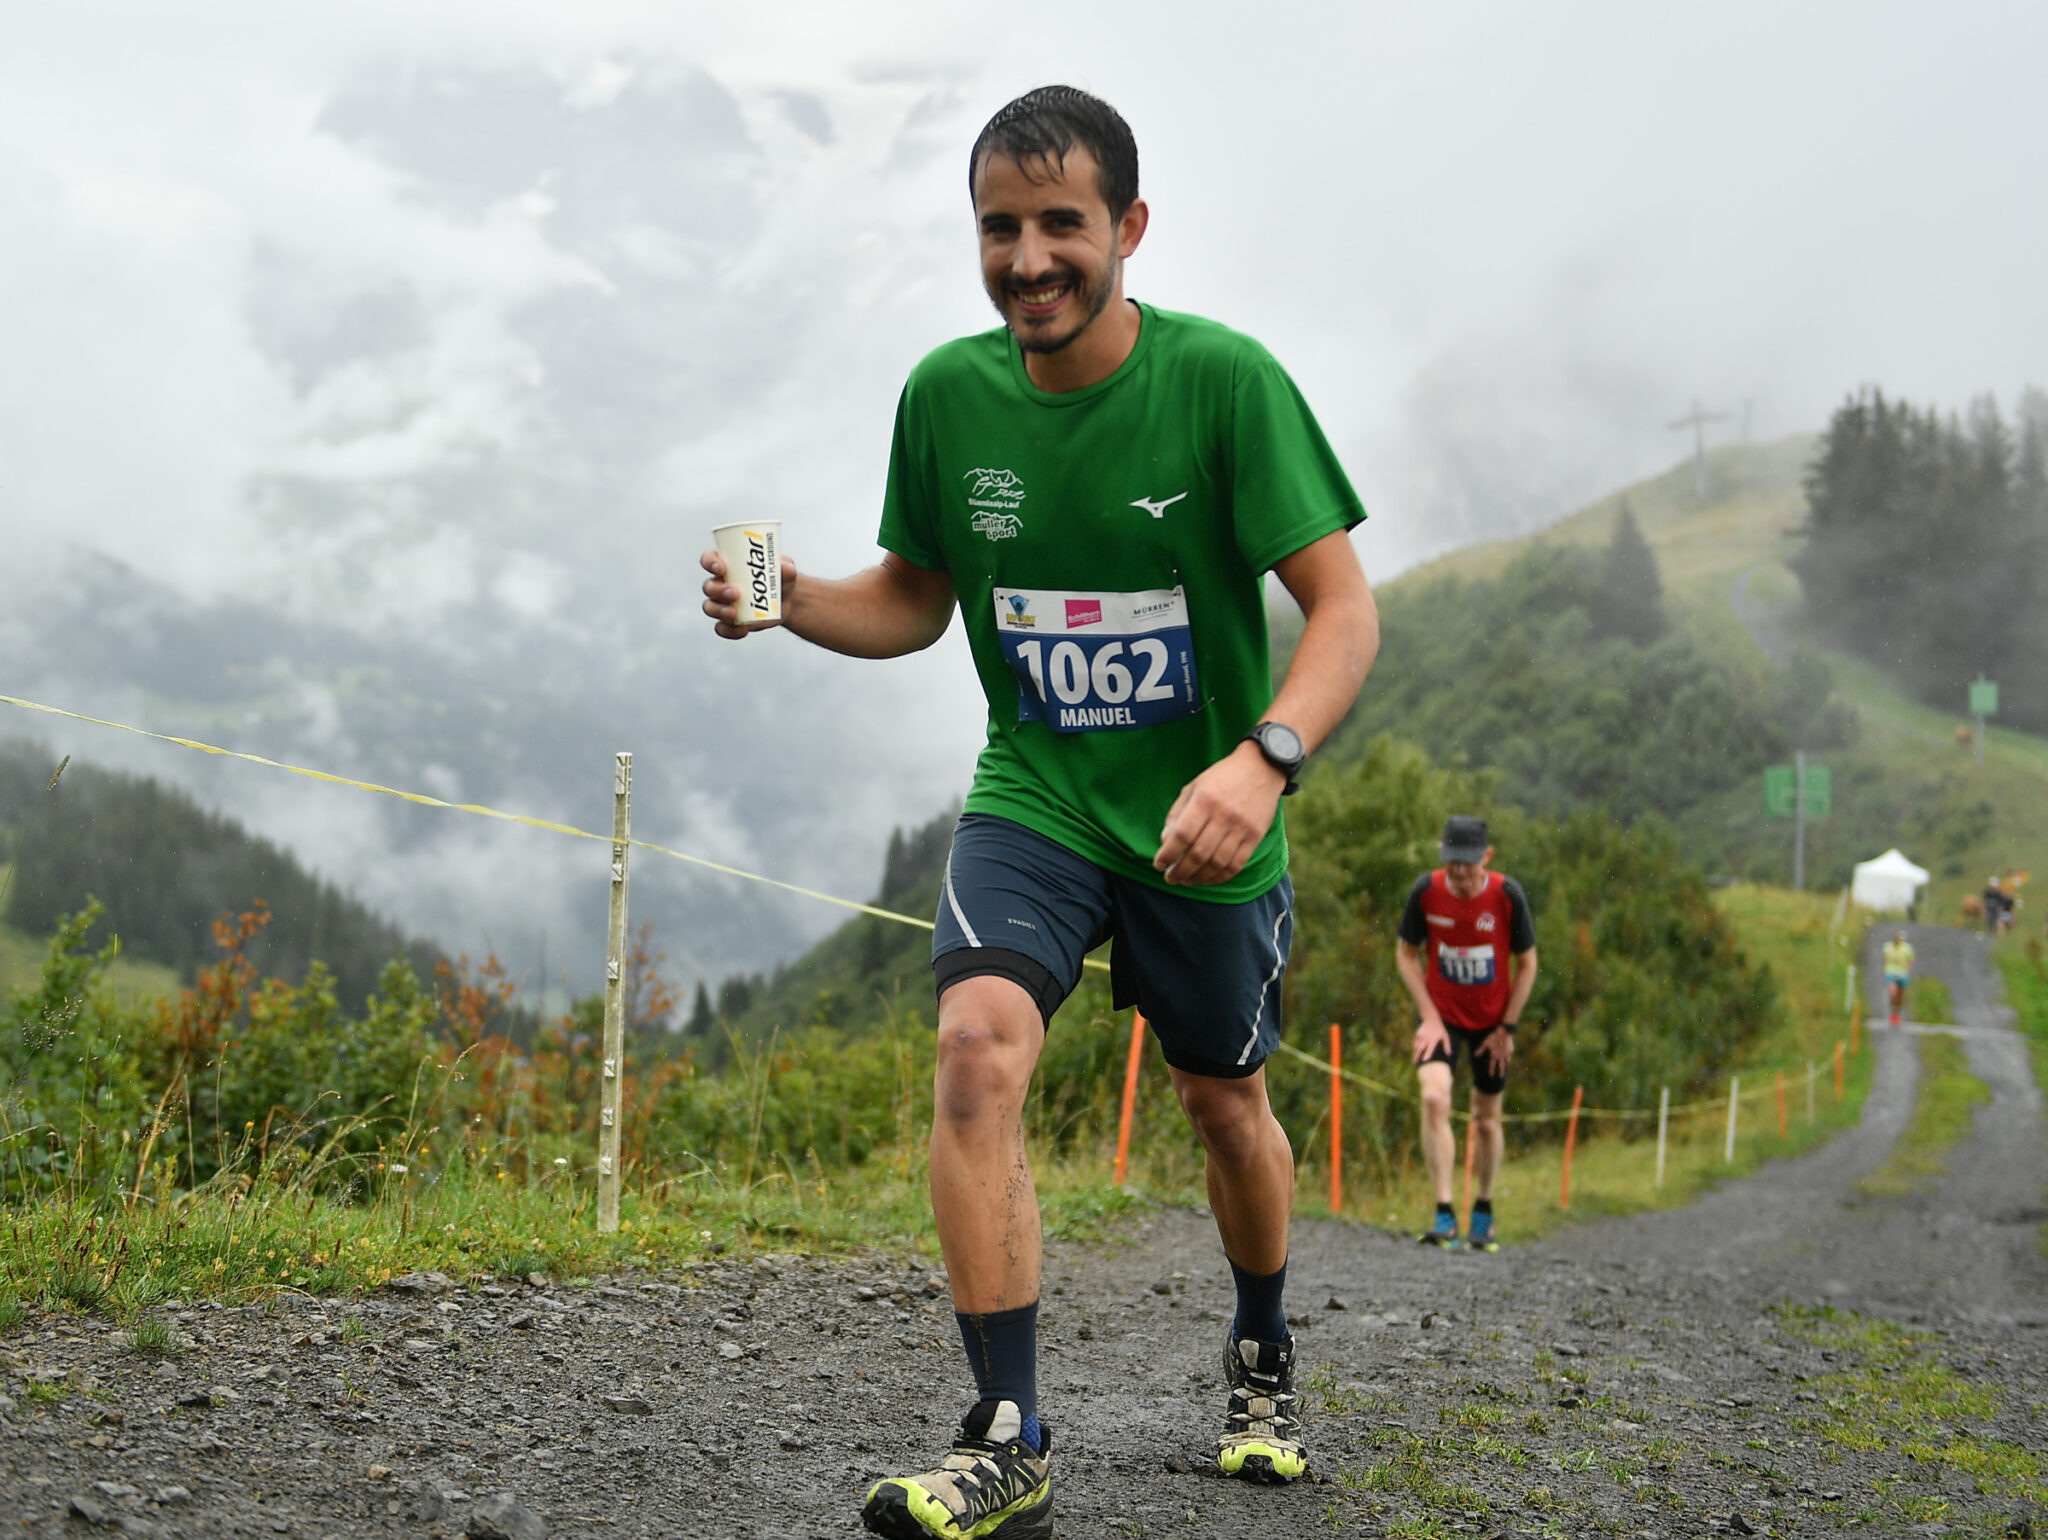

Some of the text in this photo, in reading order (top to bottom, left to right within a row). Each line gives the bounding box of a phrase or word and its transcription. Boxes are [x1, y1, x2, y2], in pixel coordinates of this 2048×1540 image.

[987, 526, 1016, 539] sport
[747, 537, 769, 612] isostar
[1134, 602, 1170, 615] MÜRREN
[1016, 638, 1175, 704] 1062
[1060, 707, 1136, 727] MANUEL
